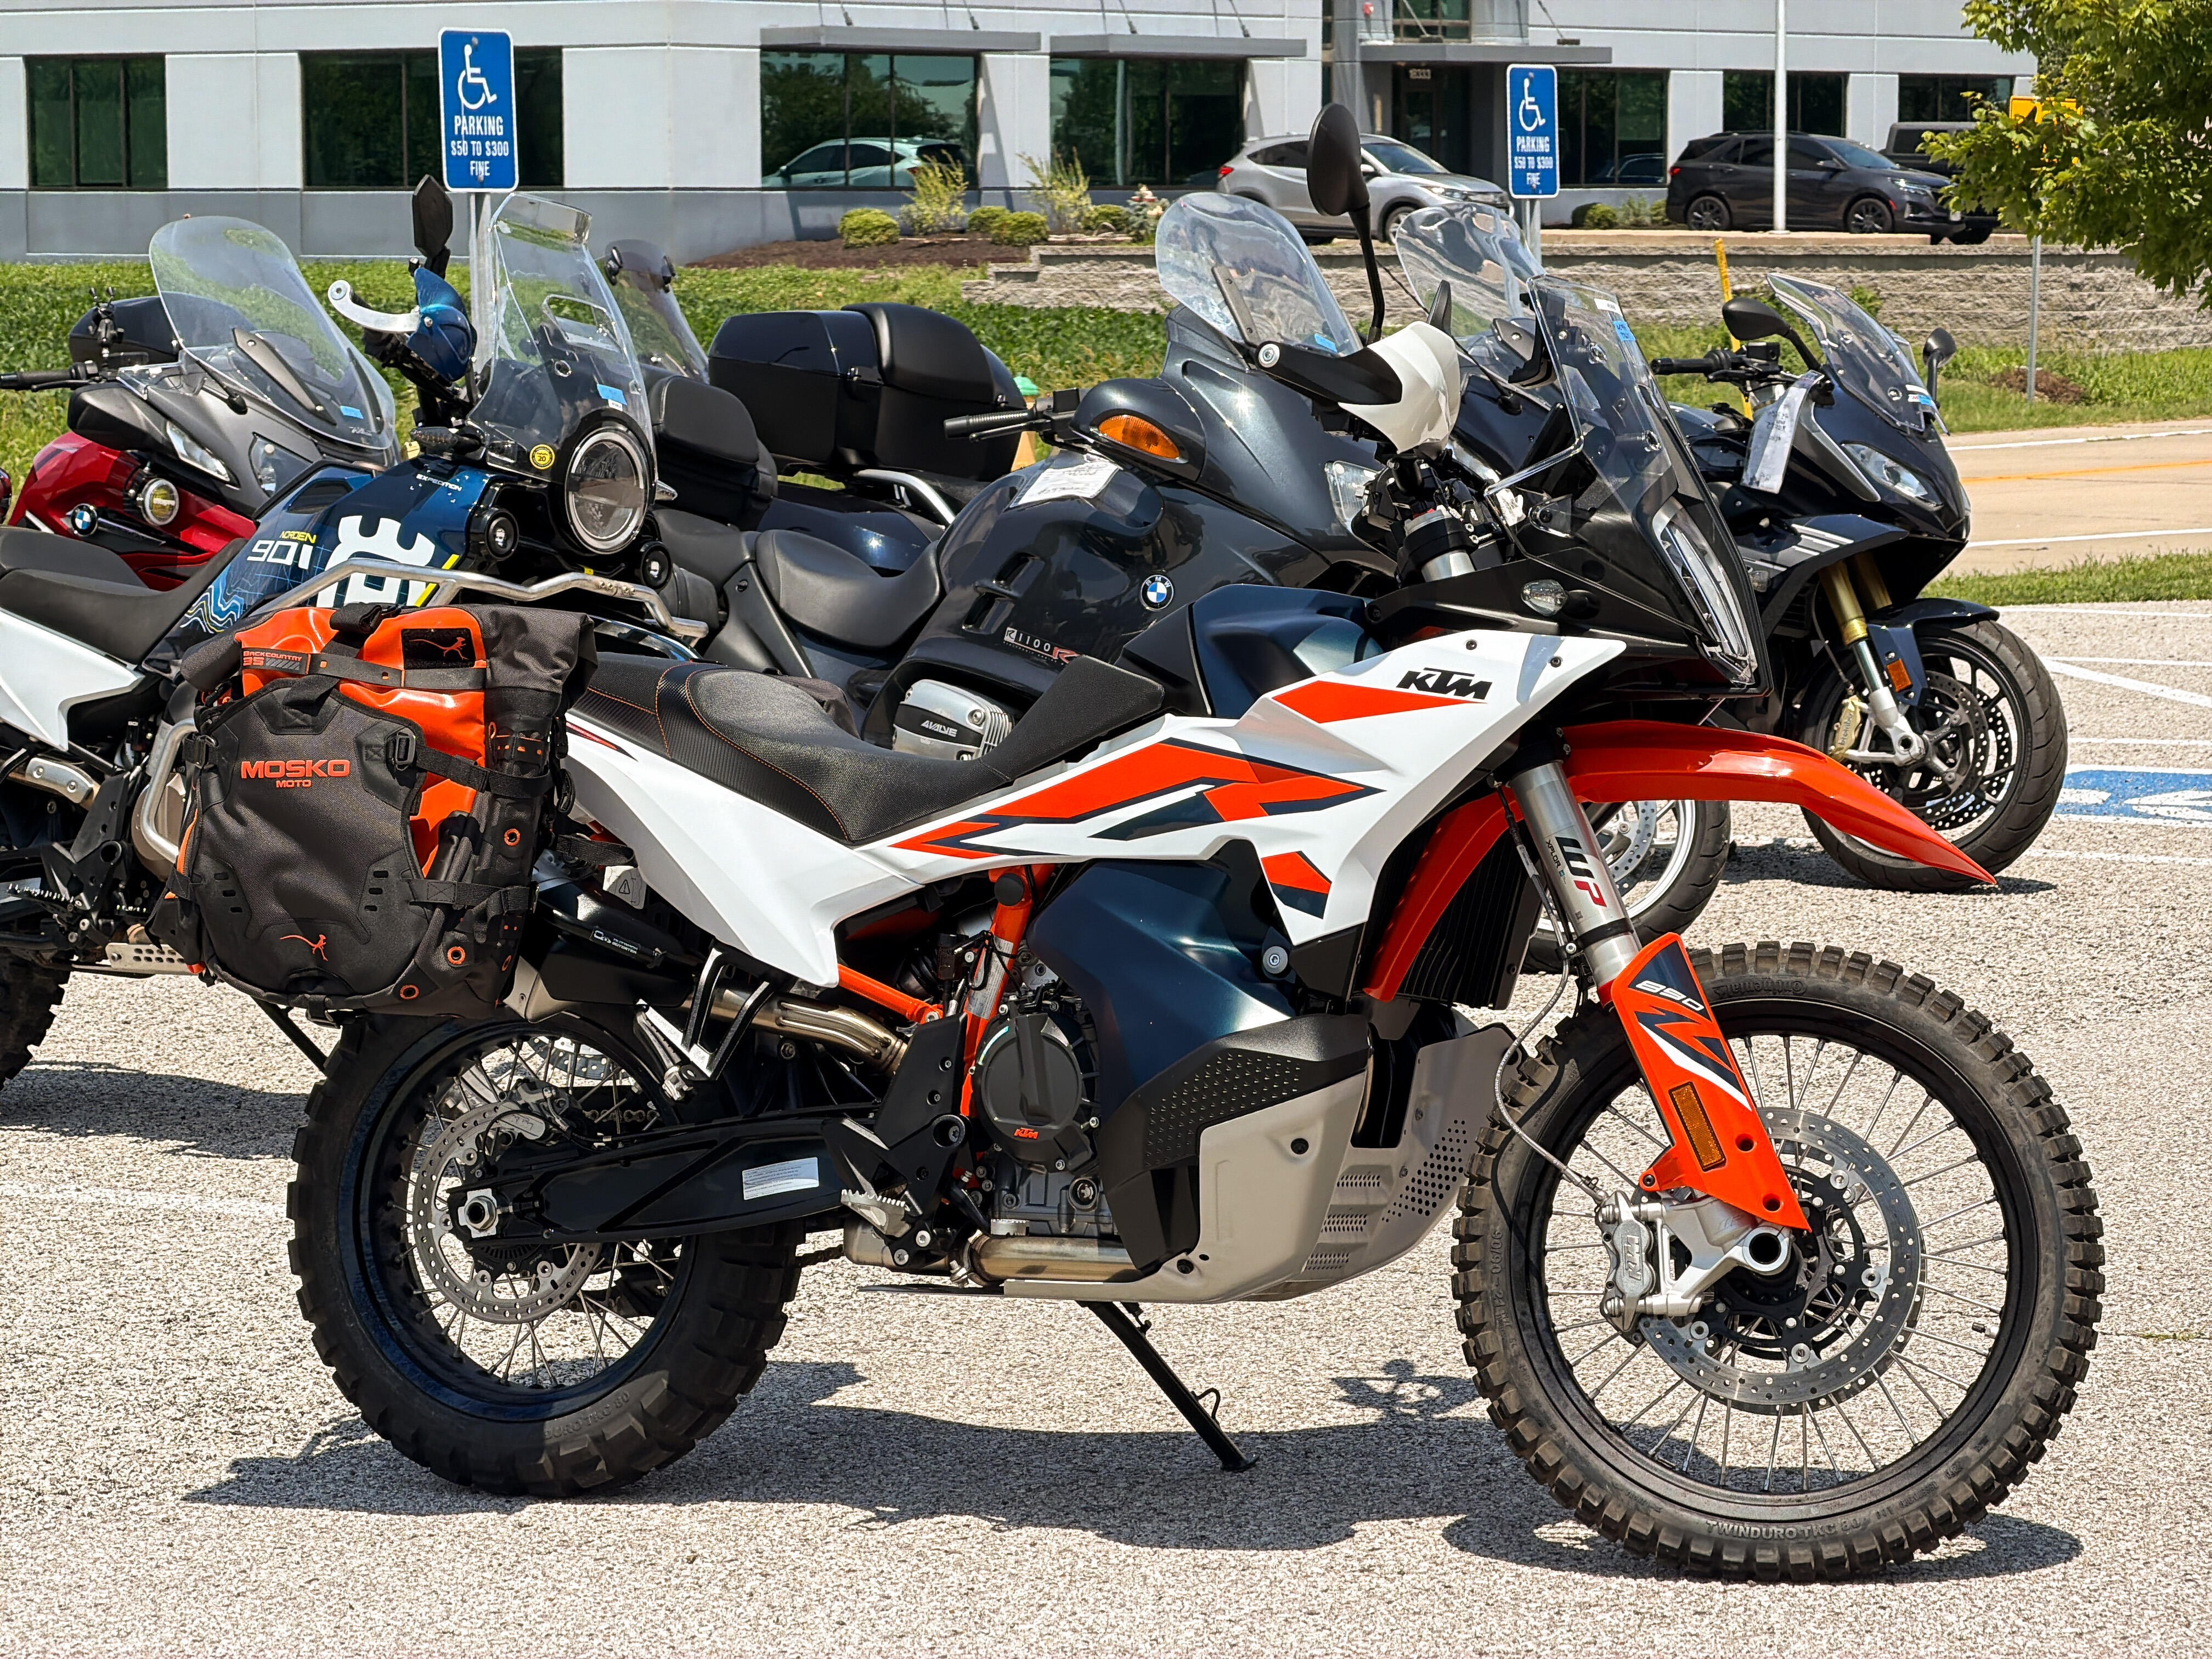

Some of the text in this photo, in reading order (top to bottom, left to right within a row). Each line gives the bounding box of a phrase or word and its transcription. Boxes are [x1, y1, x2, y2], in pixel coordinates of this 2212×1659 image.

[454, 115, 504, 136] PARKING
[451, 140, 509, 156] $50 TO $300
[1516, 136, 1550, 153] PARKING
[470, 161, 490, 176] FINE
[1514, 156, 1553, 169] $50 TO $300
[1526, 172, 1541, 185] FINE
[416, 474, 462, 491] EXPEDITION
[279, 531, 317, 544] NORDEN
[247, 540, 313, 570] 901
[1146, 576, 1171, 588] BMW
[243, 651, 302, 662] BACKCOUNTRY
[243, 657, 264, 666] 35
[1396, 667, 1493, 700] KTM
[921, 720, 957, 737] 4VALVE
[241, 759, 350, 779] MOSKO
[276, 780, 312, 788] MOTO
[1545, 839, 1561, 869] XPLOR
[1555, 837, 1607, 907] WP
[1635, 980, 1705, 1011] 890
[1014, 1127, 1039, 1139] KTM
[1624, 1235, 1641, 1280] KTM
[1706, 1517, 1860, 1540] TWINDURO TKC 80
